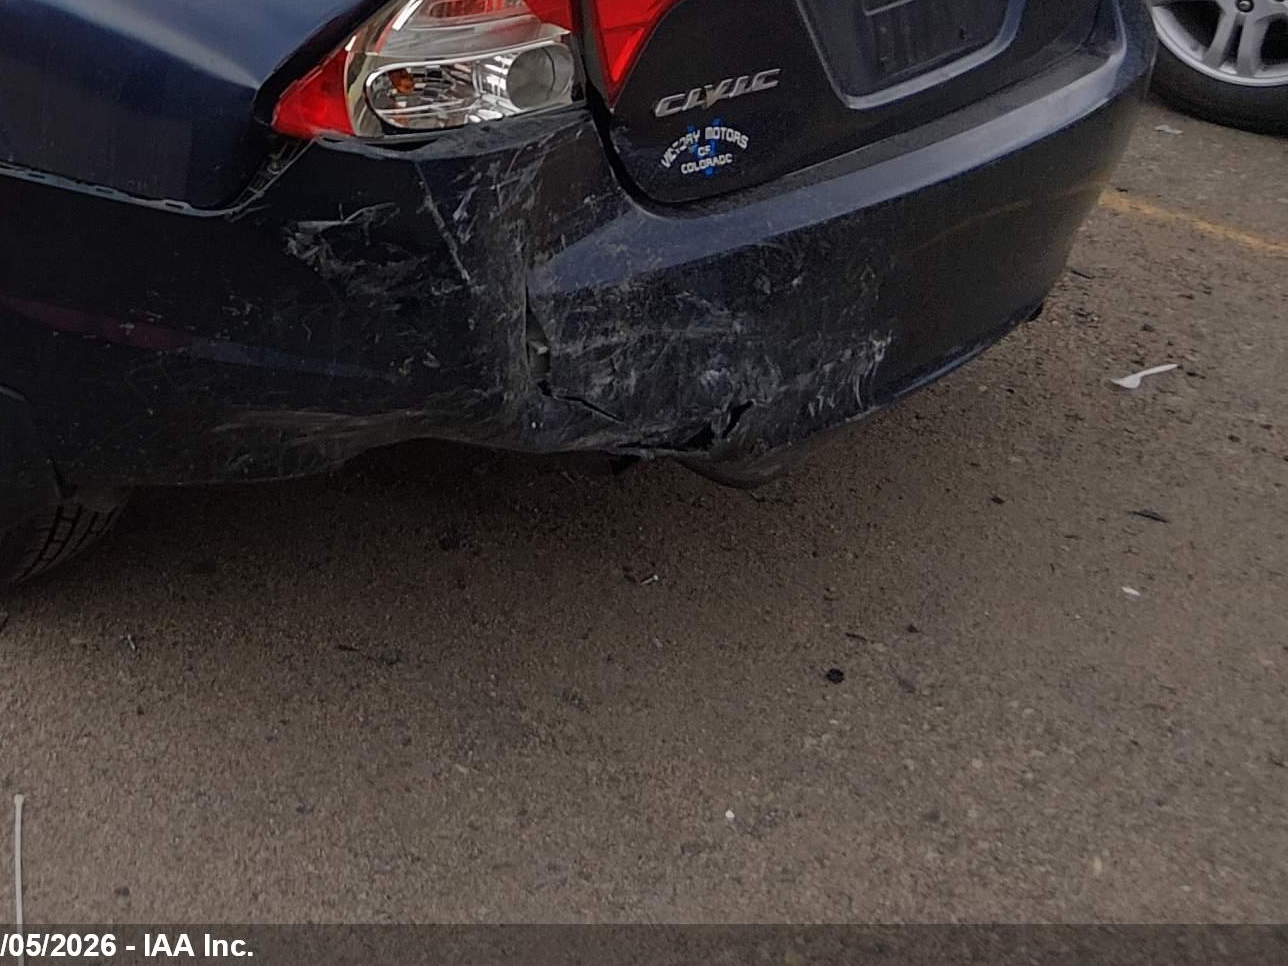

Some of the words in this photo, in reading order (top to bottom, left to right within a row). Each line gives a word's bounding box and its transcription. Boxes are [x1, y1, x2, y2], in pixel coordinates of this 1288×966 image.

[654, 68, 781, 118] CIVIC
[661, 130, 700, 167] VICTORY
[705, 127, 749, 149] MOTORS
[681, 154, 733, 174] COLORADO
